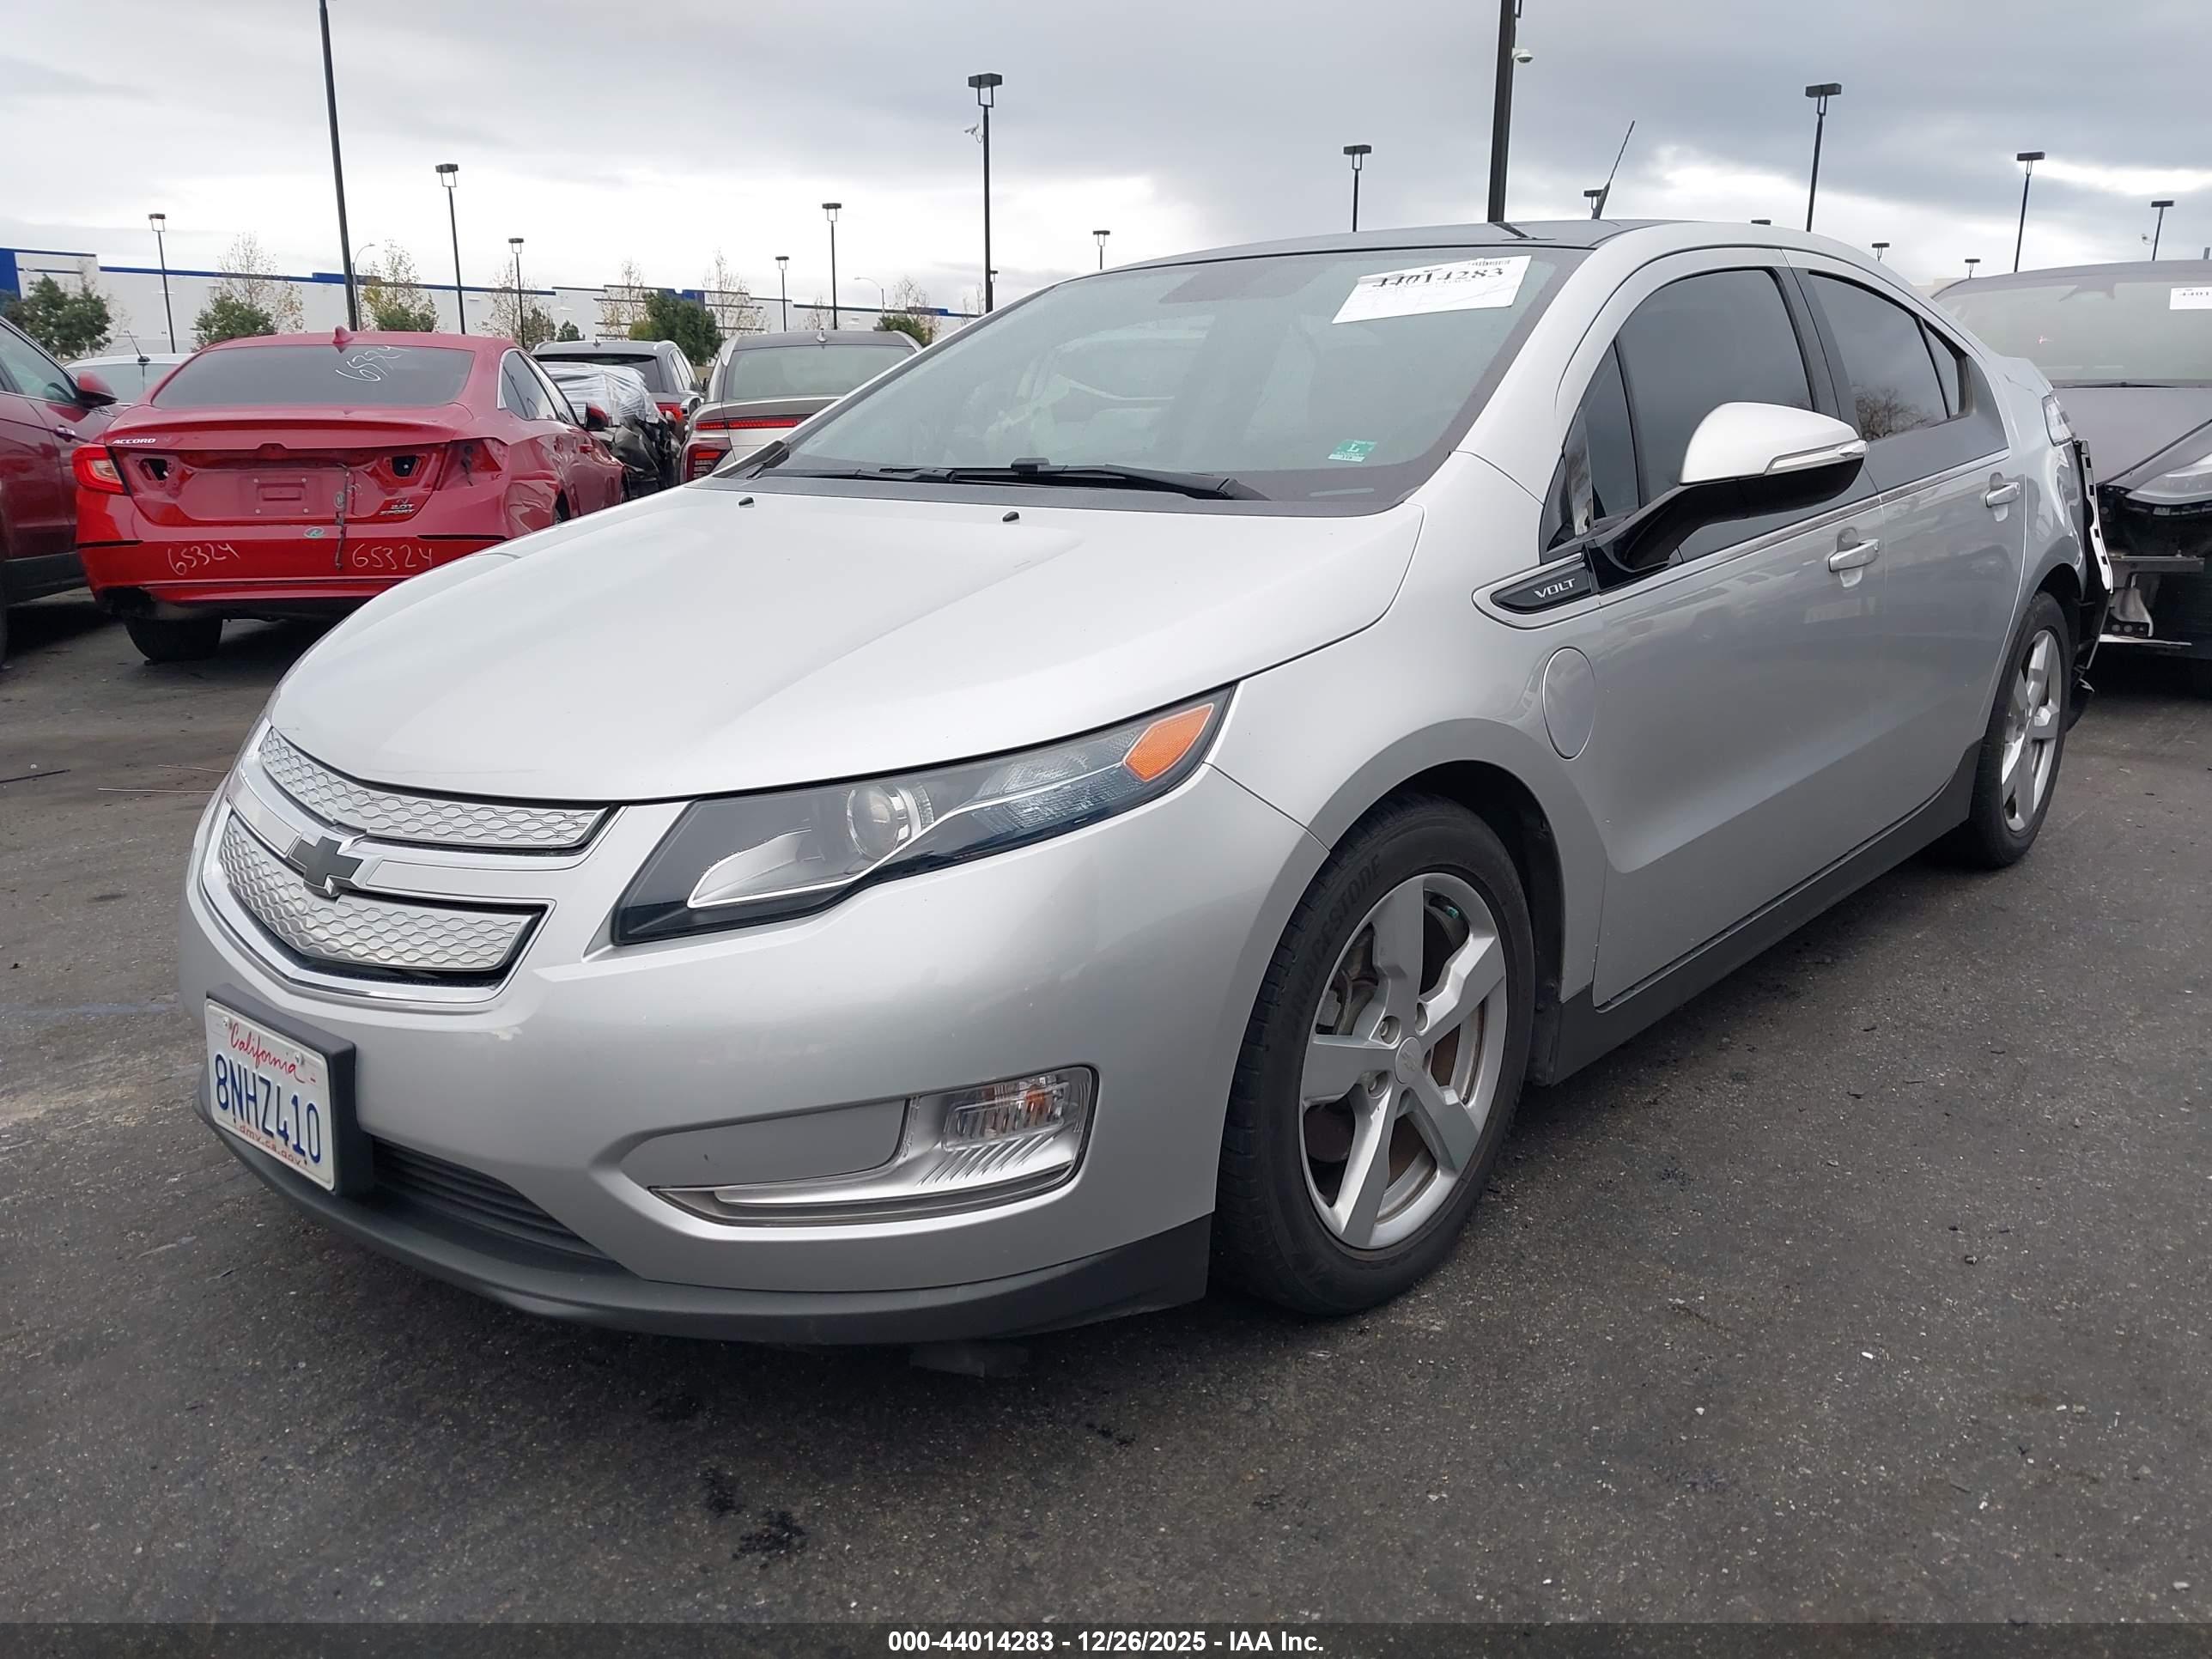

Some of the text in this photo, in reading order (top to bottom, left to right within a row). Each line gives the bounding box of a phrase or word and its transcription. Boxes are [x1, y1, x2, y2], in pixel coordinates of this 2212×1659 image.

[167, 542, 240, 576] 65324
[352, 543, 433, 570] 65324
[1534, 578, 1576, 599] VOLT
[229, 1023, 306, 1084] California
[215, 1054, 321, 1164] 8NHZ410
[240, 1124, 301, 1166] dmv.ca.gov
